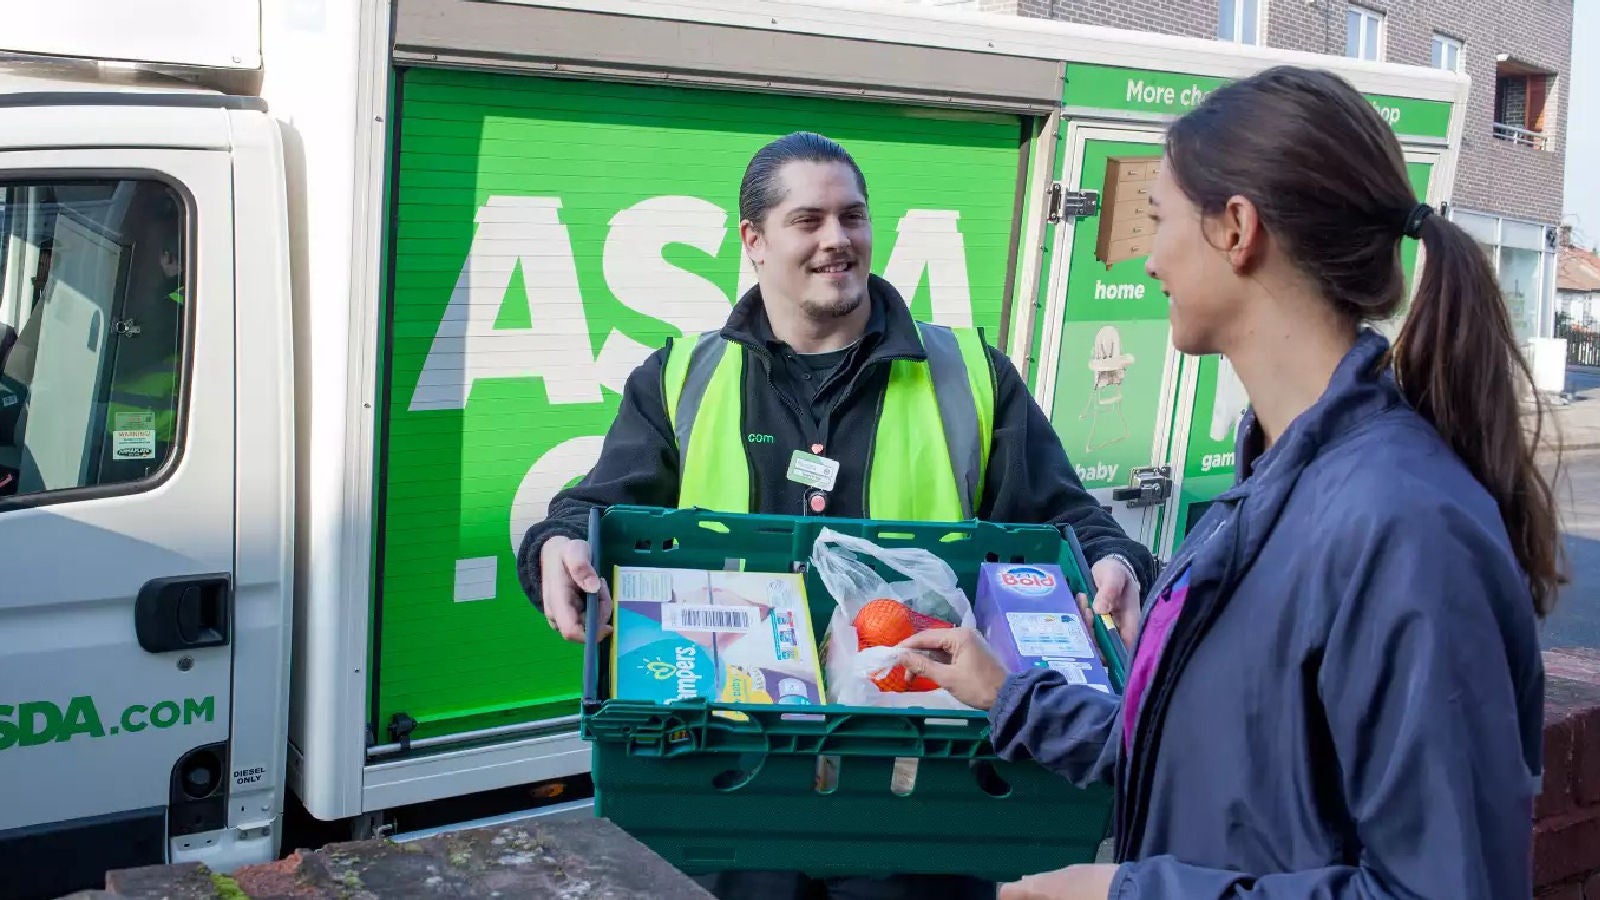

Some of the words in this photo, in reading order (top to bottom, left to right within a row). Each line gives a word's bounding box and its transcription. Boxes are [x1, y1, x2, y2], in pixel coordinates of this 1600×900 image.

[1126, 79, 1174, 104] More
[1094, 279, 1145, 300] home
[407, 194, 974, 411] ASA
[1074, 461, 1119, 483] baby
[1200, 451, 1235, 472] gam
[1001, 572, 1056, 587] Bold
[233, 767, 266, 778] DIESEL
[236, 774, 262, 785] ONLY
